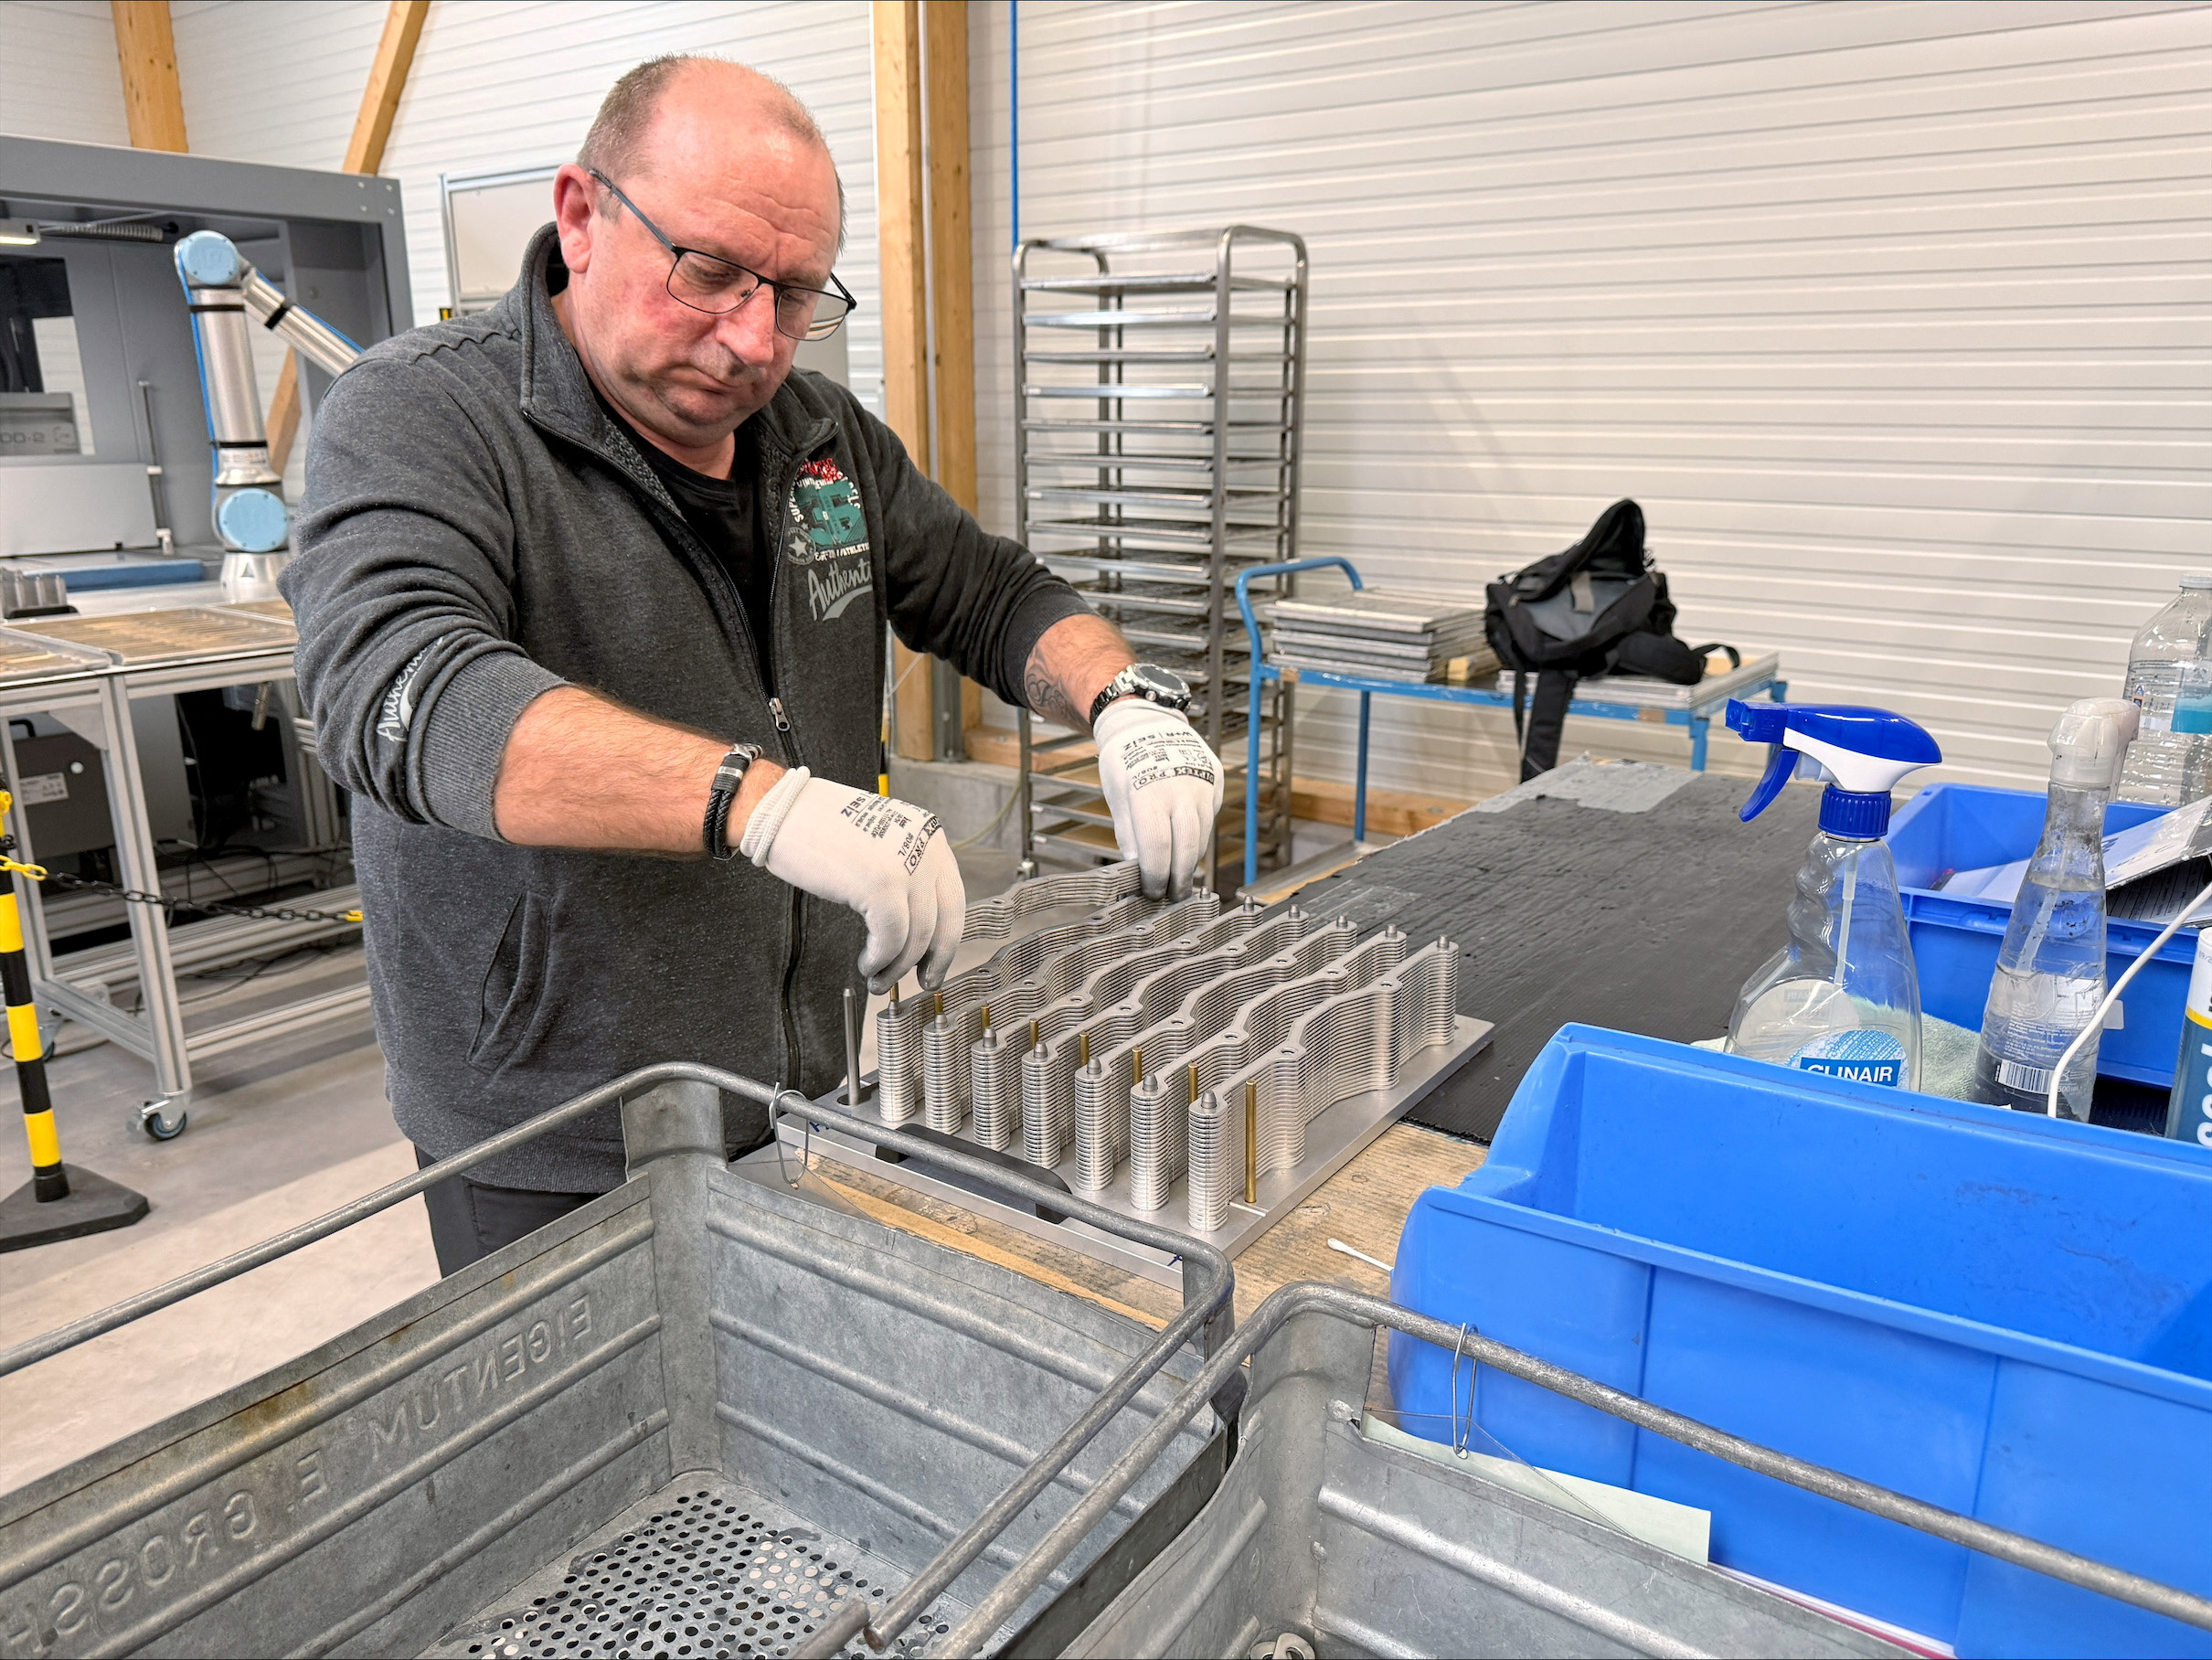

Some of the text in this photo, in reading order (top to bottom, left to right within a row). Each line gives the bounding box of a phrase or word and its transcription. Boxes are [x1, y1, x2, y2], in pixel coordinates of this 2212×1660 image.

[807, 557, 873, 622] Authenti
[1138, 771, 1167, 785] PRO
[909, 835, 926, 867] PRO
